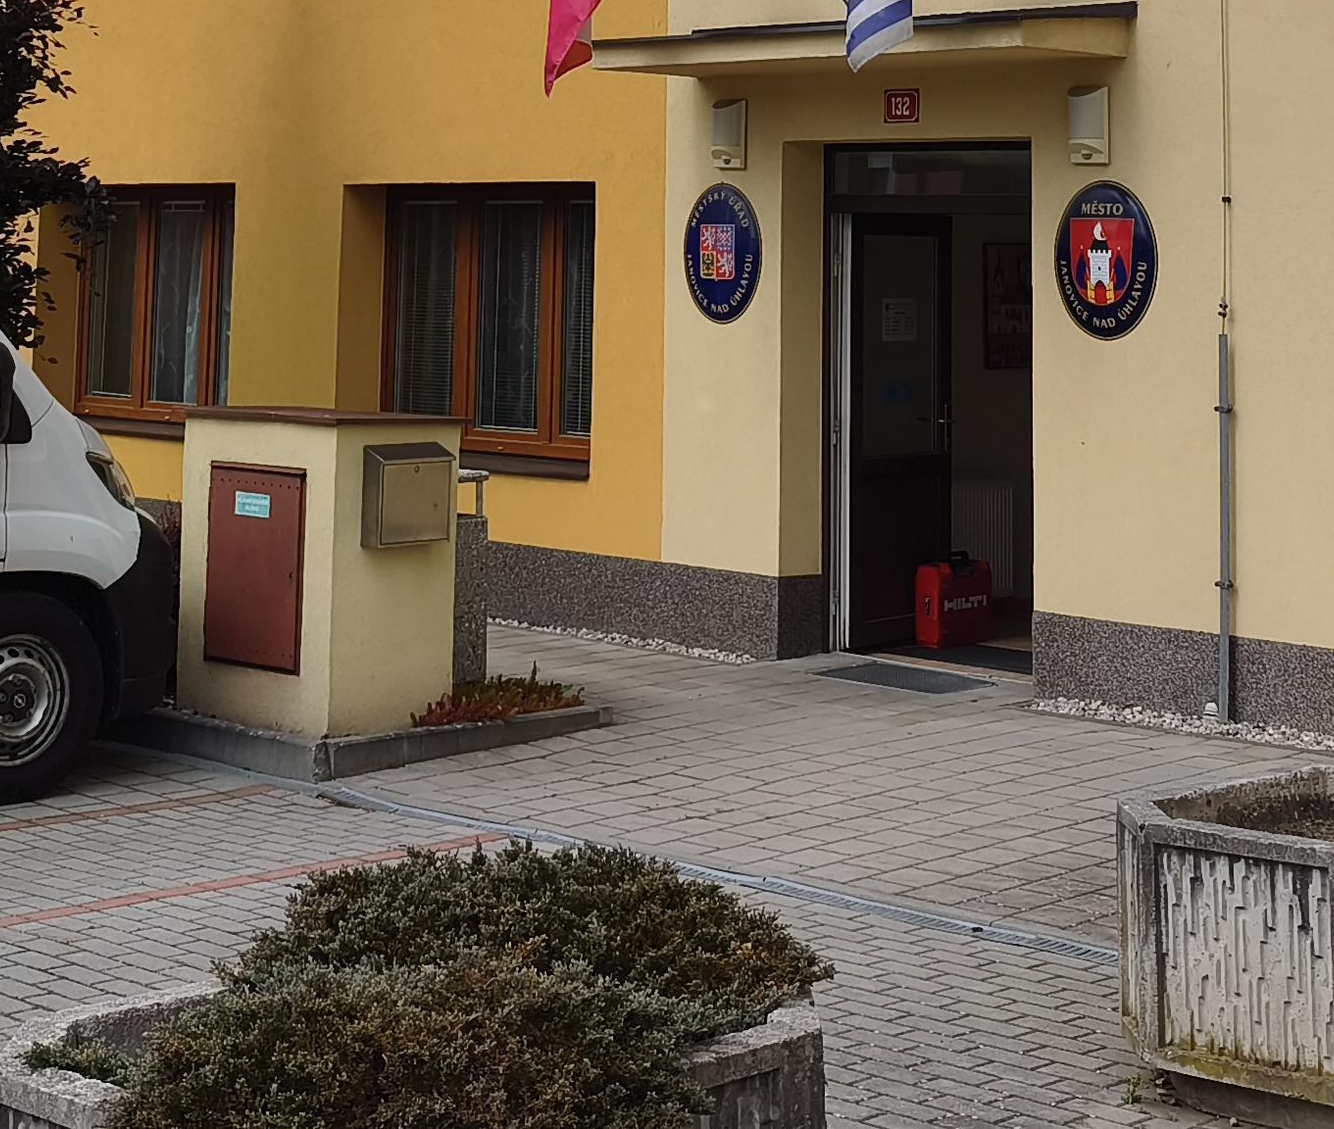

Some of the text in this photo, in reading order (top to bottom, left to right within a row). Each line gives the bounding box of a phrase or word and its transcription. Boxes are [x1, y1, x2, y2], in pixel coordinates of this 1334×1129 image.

[891, 97, 910, 115] 132
[1081, 200, 1124, 215] MĚSTO
[687, 254, 708, 308] JANOVICE
[711, 303, 730, 314] NAD
[1060, 260, 1147, 328] JANOVICE NAD ÚHLAVOU
[944, 594, 987, 612] HILTI
